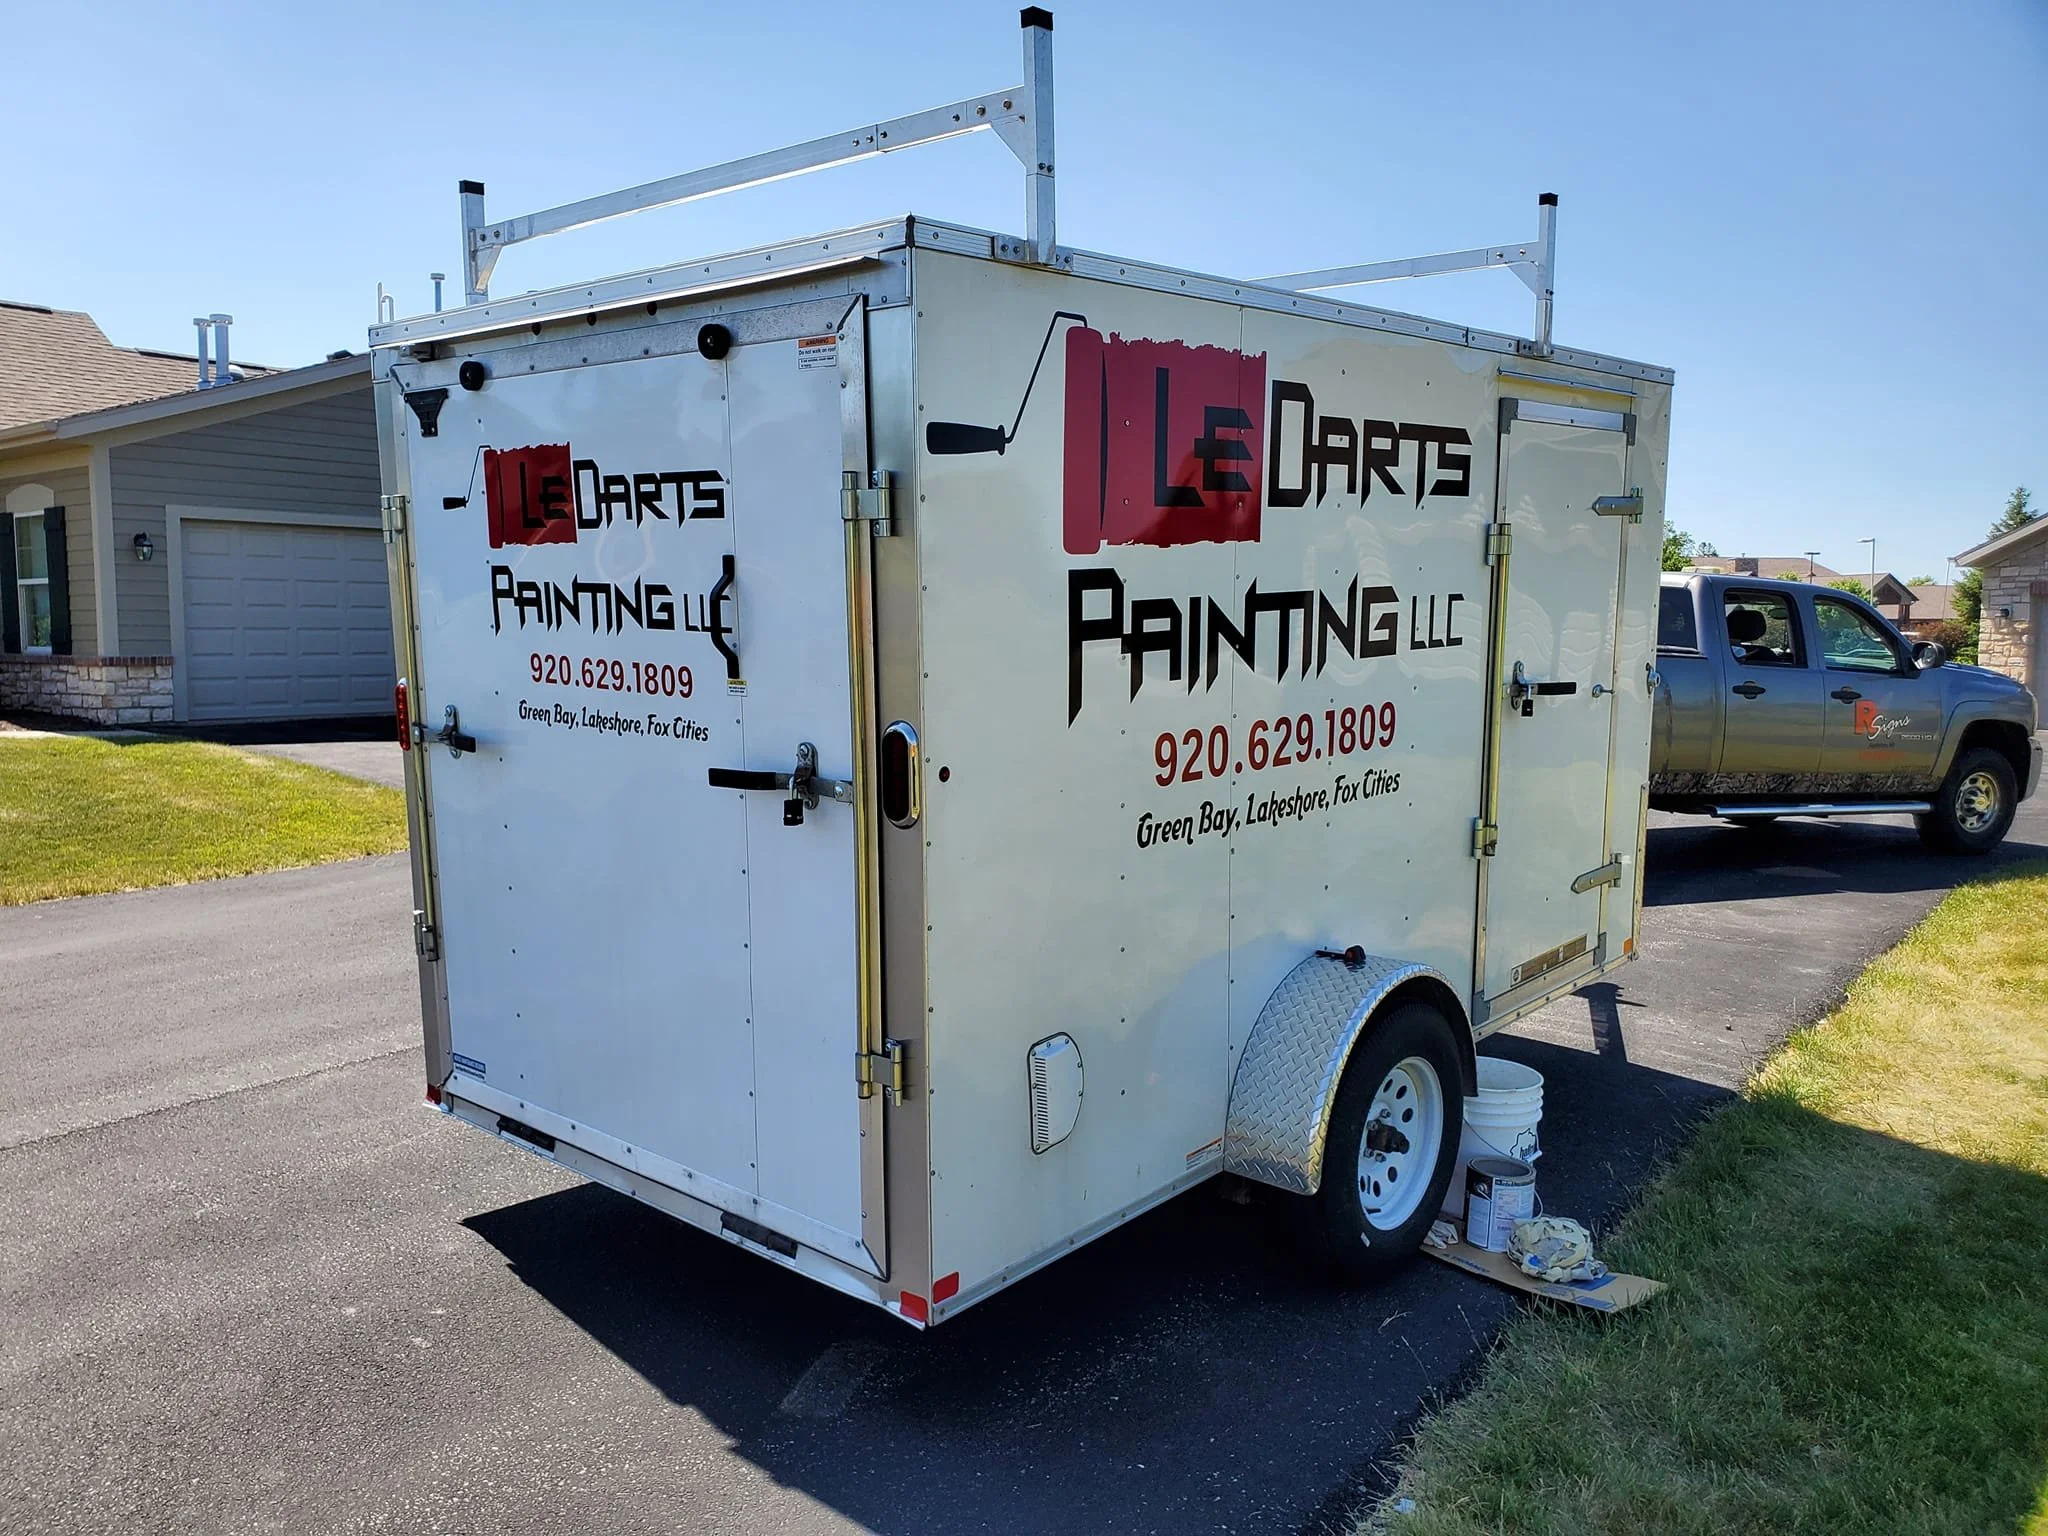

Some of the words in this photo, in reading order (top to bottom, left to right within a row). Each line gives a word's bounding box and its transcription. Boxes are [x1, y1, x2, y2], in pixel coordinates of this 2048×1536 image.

[1410, 593, 1465, 651] LLC
[530, 653, 693, 698] 920.629.1809
[518, 700, 552, 727] Green
[553, 703, 579, 730] Bay,
[582, 706, 644, 736] Lakeshore,
[647, 714, 670, 737] Fox
[673, 716, 709, 742] Cities
[1154, 701, 1397, 787] 920.629.1809
[1868, 715, 1912, 740] Signs
[1136, 812, 1194, 848] Green
[1198, 801, 1241, 838] Bay,
[1246, 786, 1330, 827] Lakeshore,
[1334, 774, 1361, 806] Fox
[1363, 768, 1401, 799] Cities
